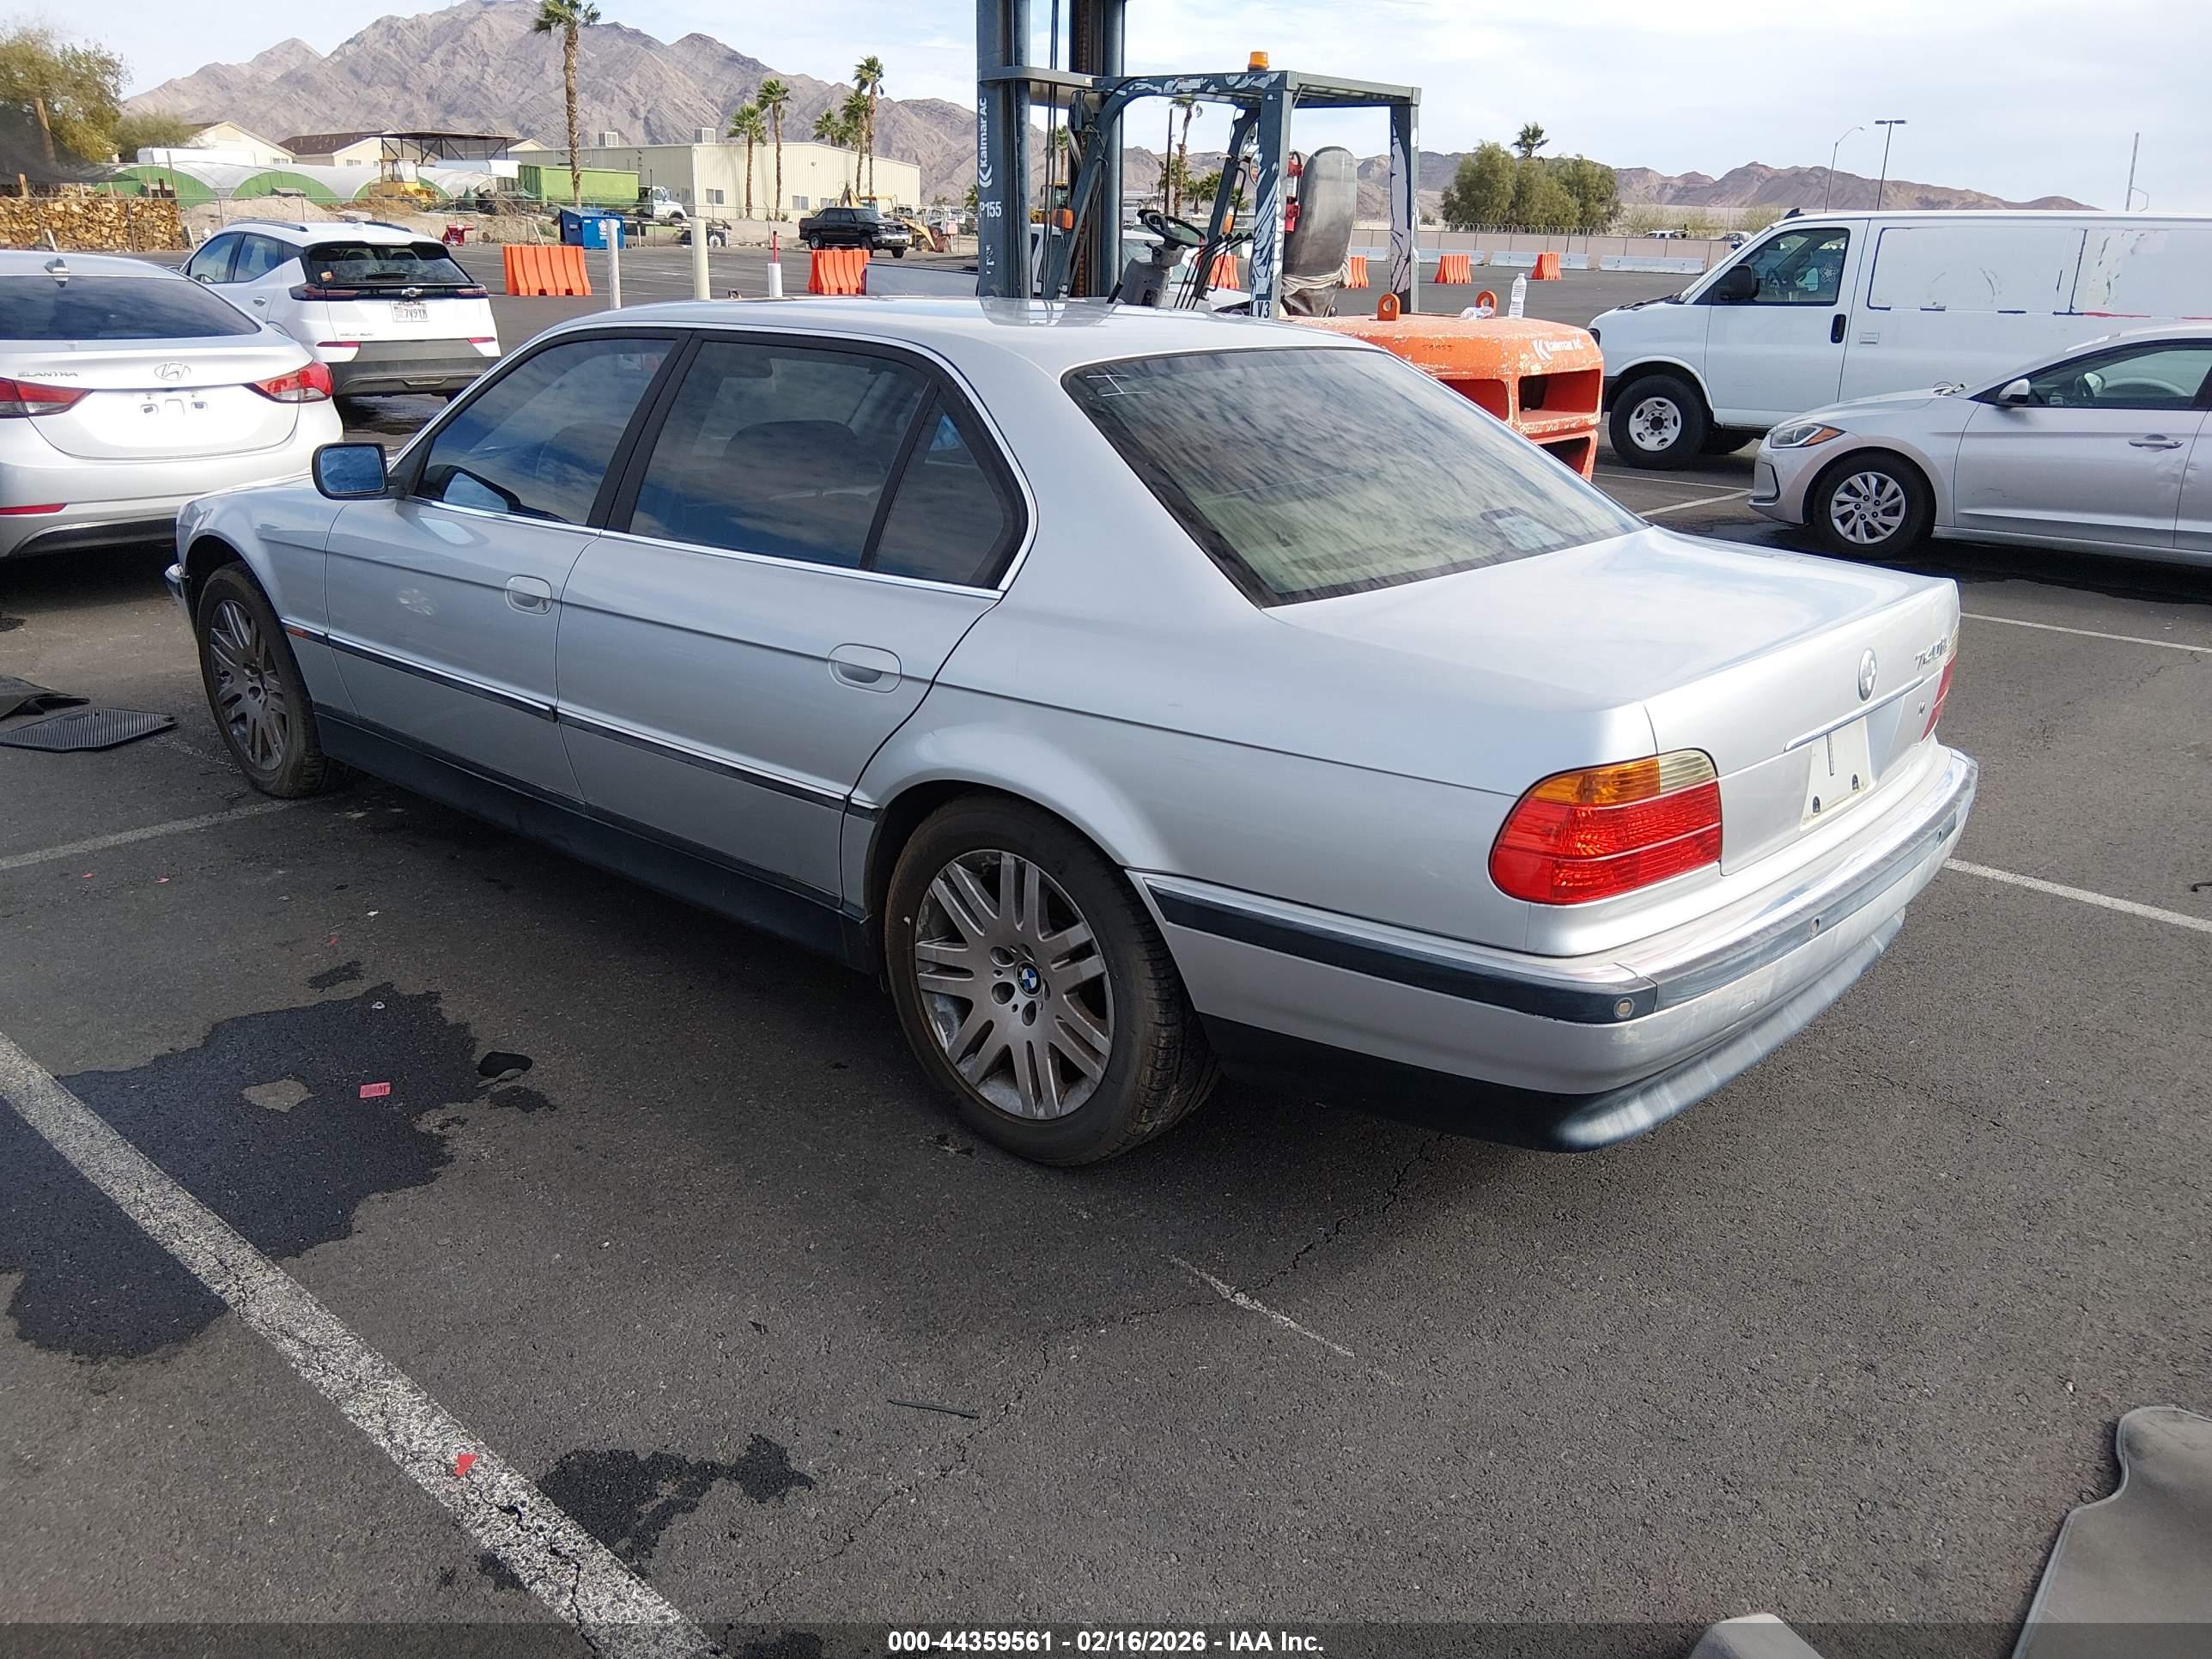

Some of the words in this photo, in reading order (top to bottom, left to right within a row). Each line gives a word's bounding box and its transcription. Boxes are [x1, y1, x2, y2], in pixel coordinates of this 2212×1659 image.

[979, 97, 988, 116] AC
[979, 117, 988, 167] Kalmar
[979, 201, 1002, 218] P155
